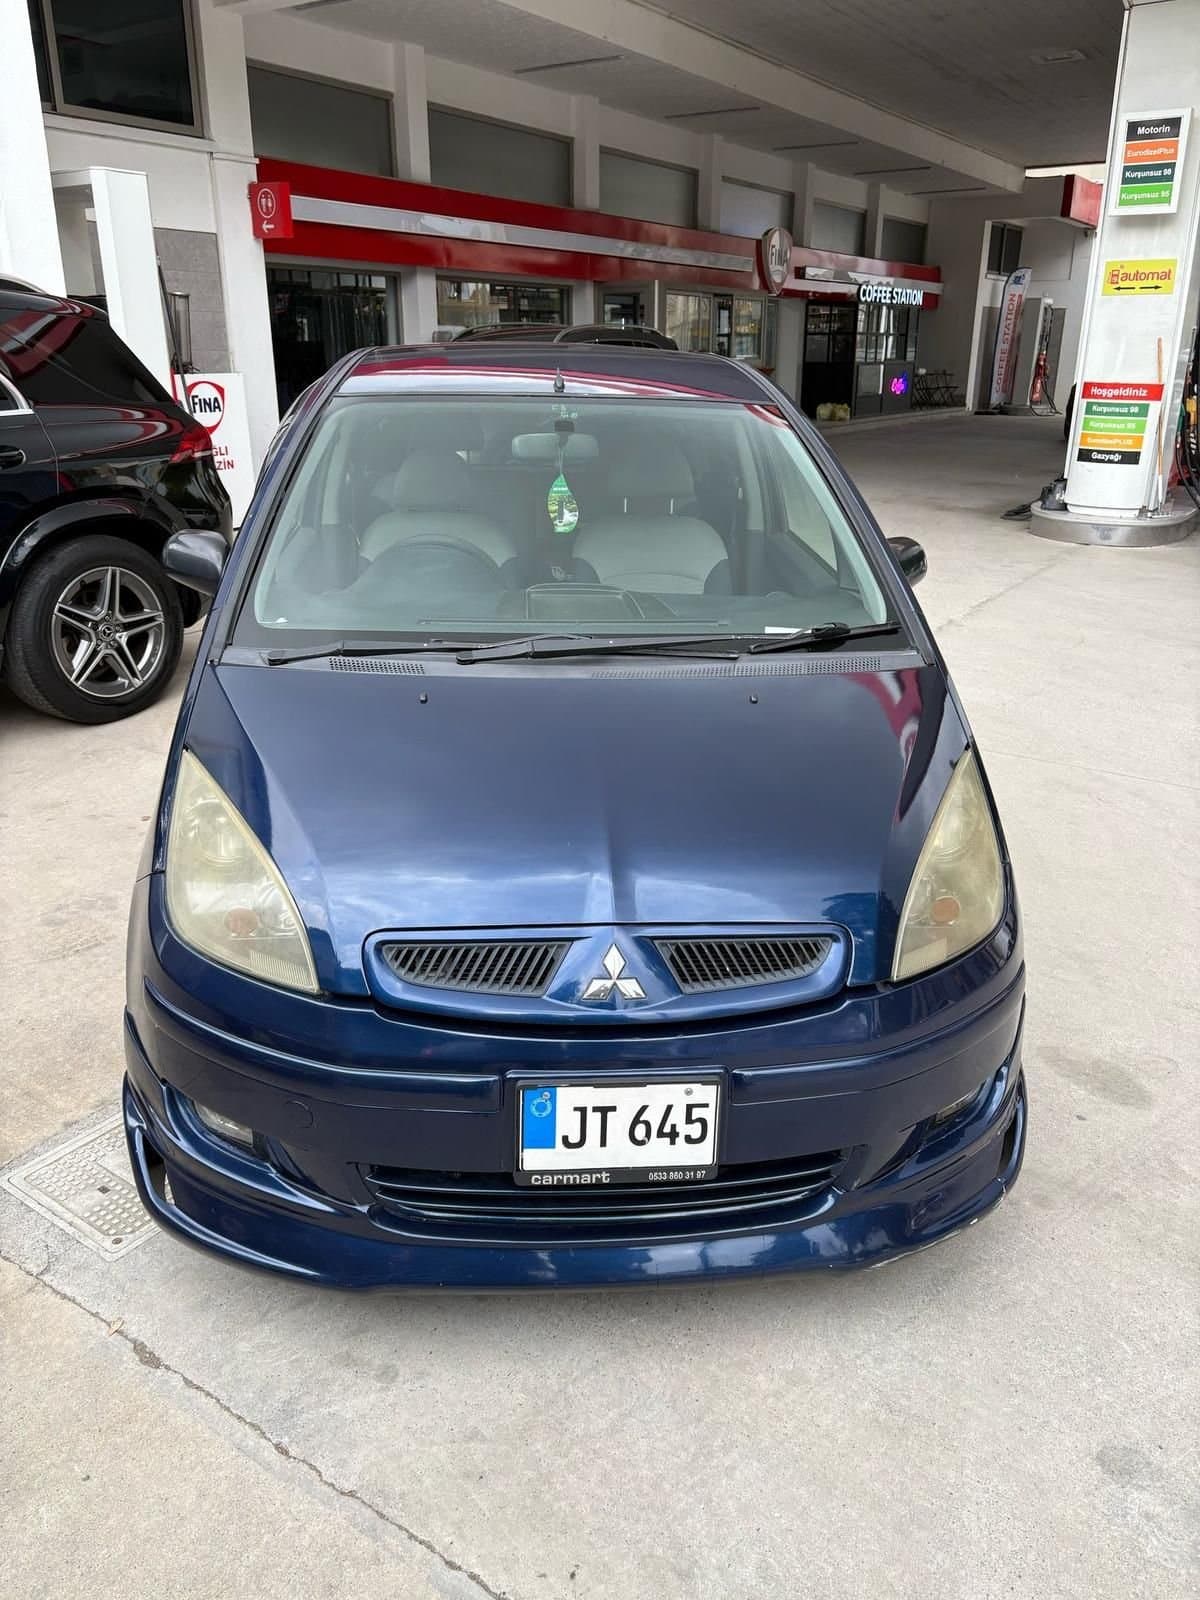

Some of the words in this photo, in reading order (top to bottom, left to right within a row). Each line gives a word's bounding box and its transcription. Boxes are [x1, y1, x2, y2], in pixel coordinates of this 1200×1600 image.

[1137, 124, 1171, 135] Motorin
[1125, 169, 1162, 179] Kurşunsuz
[1121, 191, 1159, 201] Kurşunsuz
[1120, 268, 1172, 282] automat
[860, 285, 893, 303] COFFEE
[892, 287, 923, 306] STATION
[1003, 293, 1017, 345] STATION
[1091, 386, 1148, 398] Hoşgeldiniz
[192, 394, 222, 414] FINA
[1092, 405, 1129, 414] Kurşunsuz
[1091, 452, 1122, 462] Gazyağı
[216, 458, 234, 470] ZİN
[562, 1105, 617, 1149] JT
[628, 1103, 710, 1147] 645
[531, 1171, 610, 1185] carmart
[649, 1171, 667, 1181] 0533
[684, 1170, 694, 1180] 31
